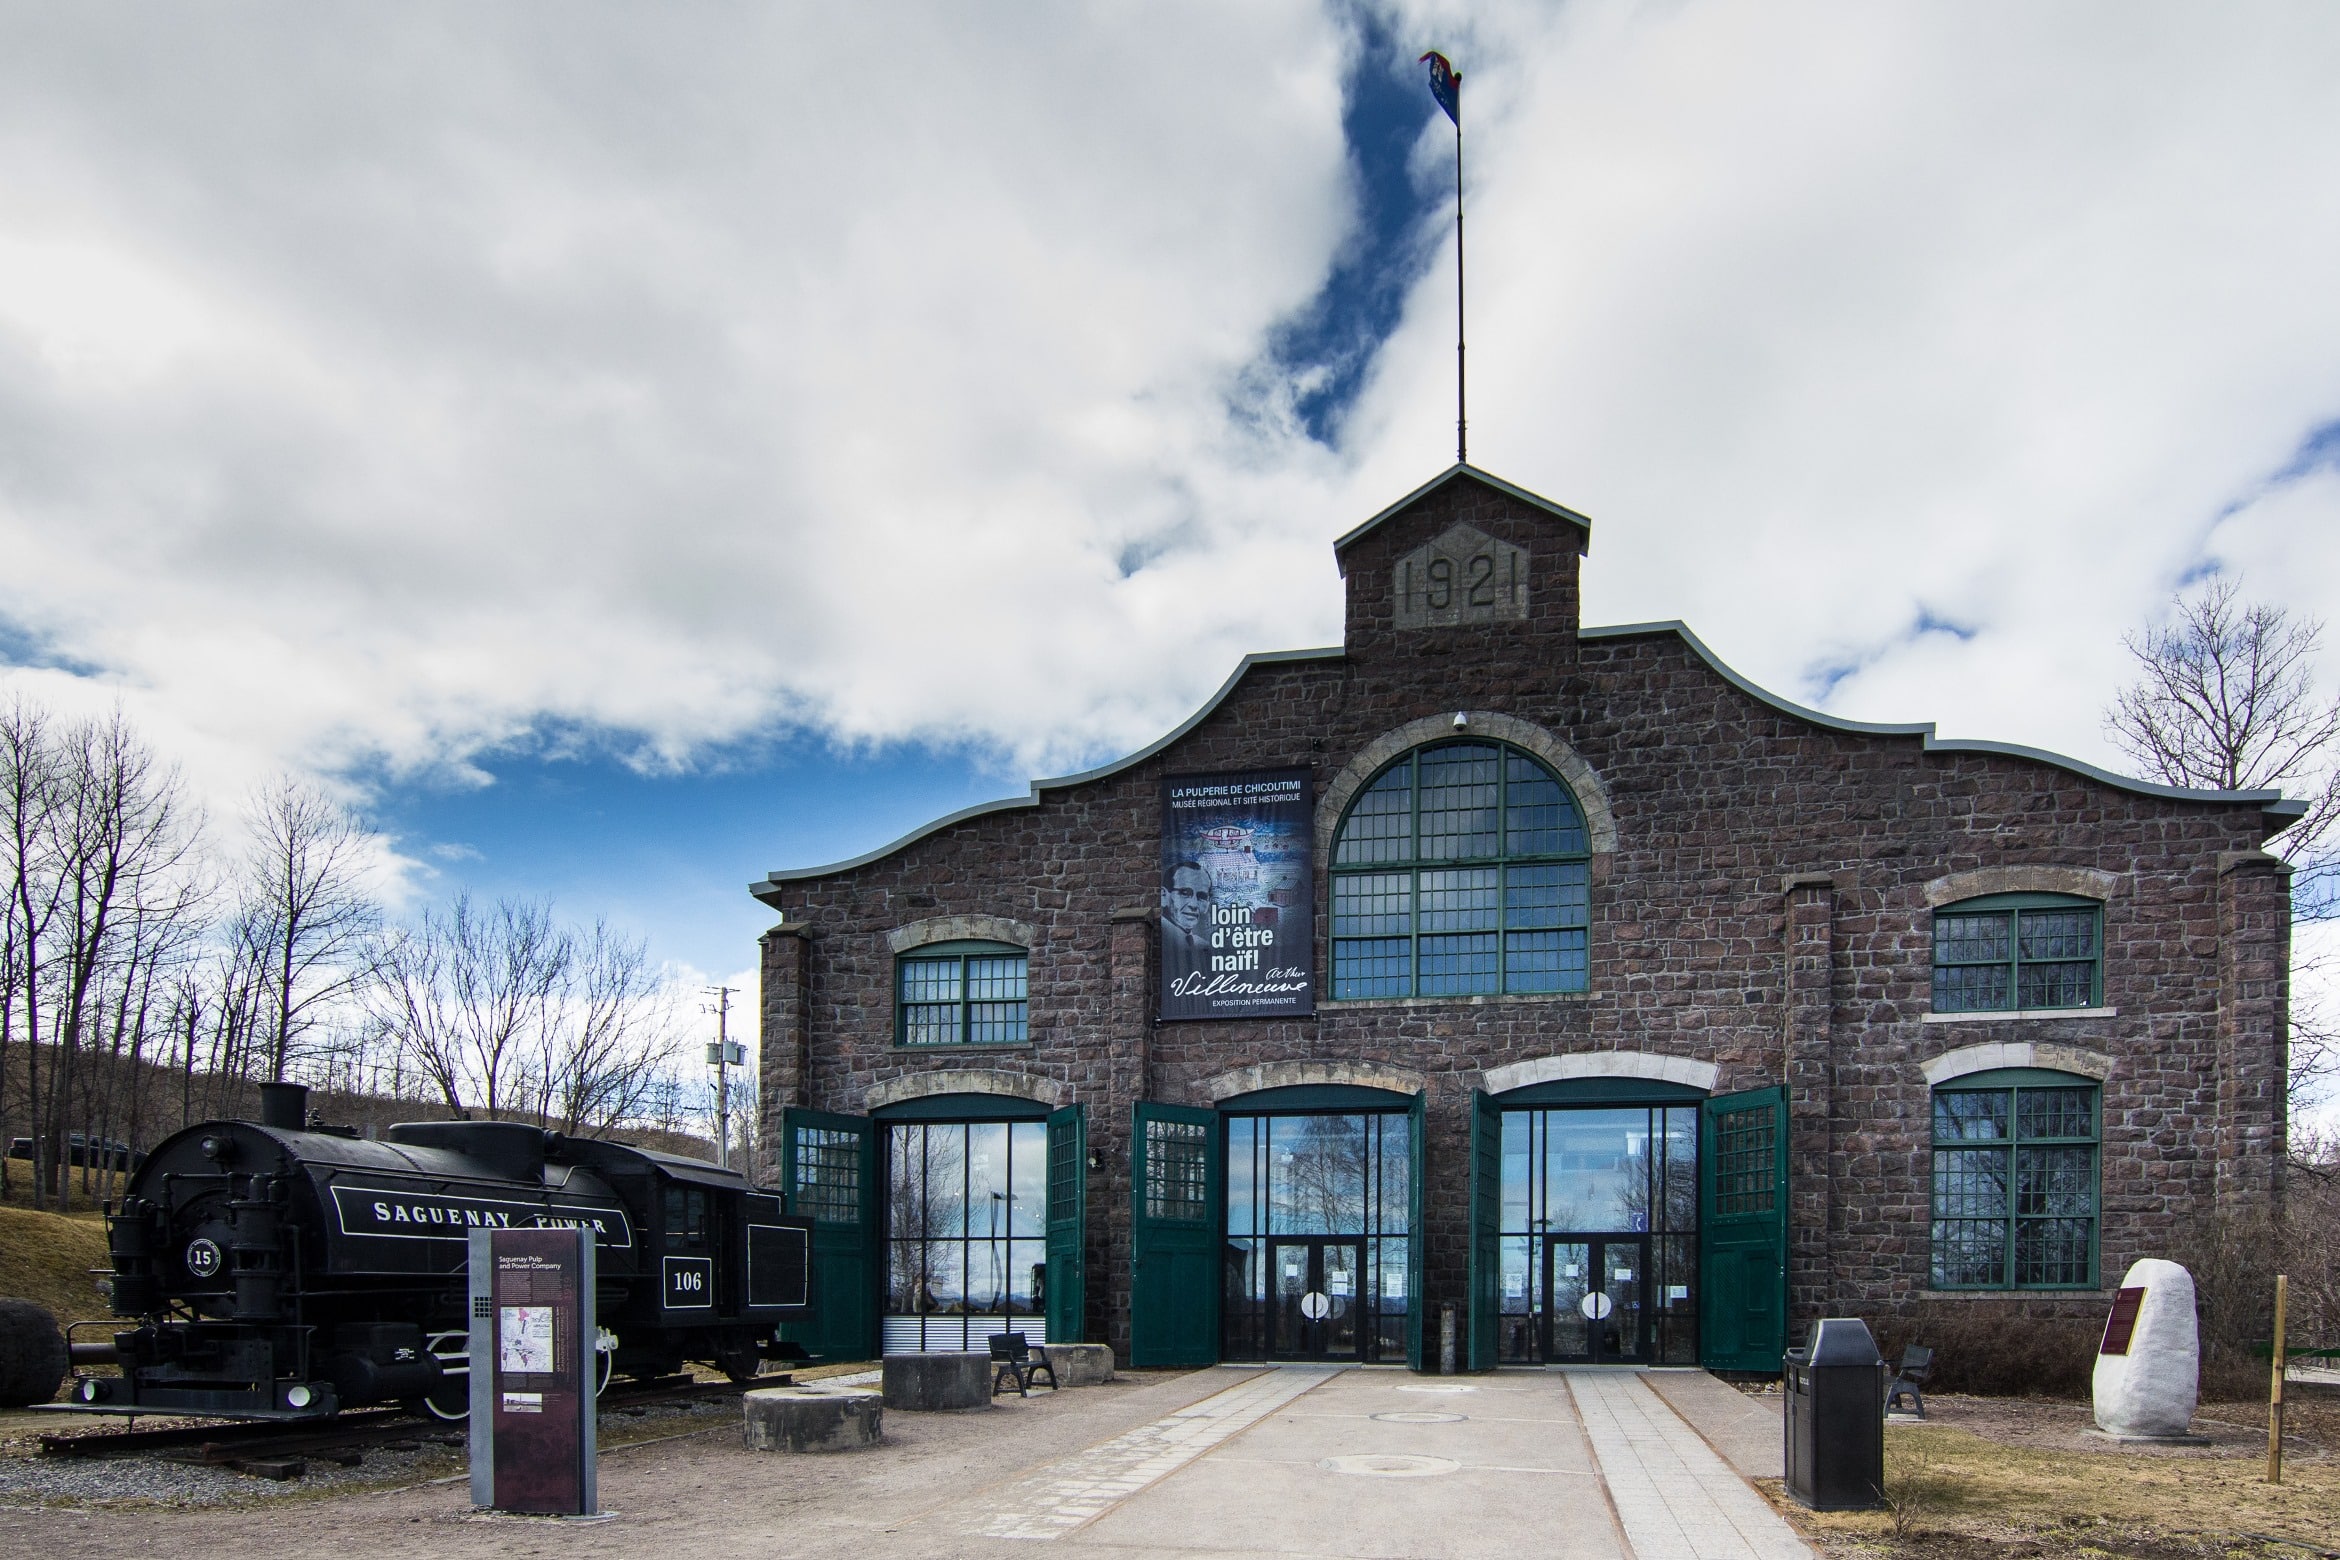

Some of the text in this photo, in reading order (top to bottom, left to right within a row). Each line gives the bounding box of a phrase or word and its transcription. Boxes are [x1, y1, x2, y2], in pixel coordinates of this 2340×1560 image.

[1405, 551, 1517, 614] 1921
[1172, 780, 1301, 798] LA PULPERIE DE CHICOUTIMI
[1172, 792, 1301, 809] MUSÉE RÉGIONAL ET SITE HISTORIQUE
[1211, 903, 1250, 925] loin
[1211, 927, 1274, 948] d'être
[1211, 949, 1259, 972] naïf!
[1170, 971, 1308, 997] Villeneuve
[1212, 997, 1297, 1007] EXPOSITION PERMANENTE
[374, 1202, 510, 1228] SAGUENAY
[195, 1250, 211, 1265] 15
[498, 1256, 528, 1264] Saguenay
[531, 1263, 562, 1271] Company
[674, 1271, 702, 1291] 106
